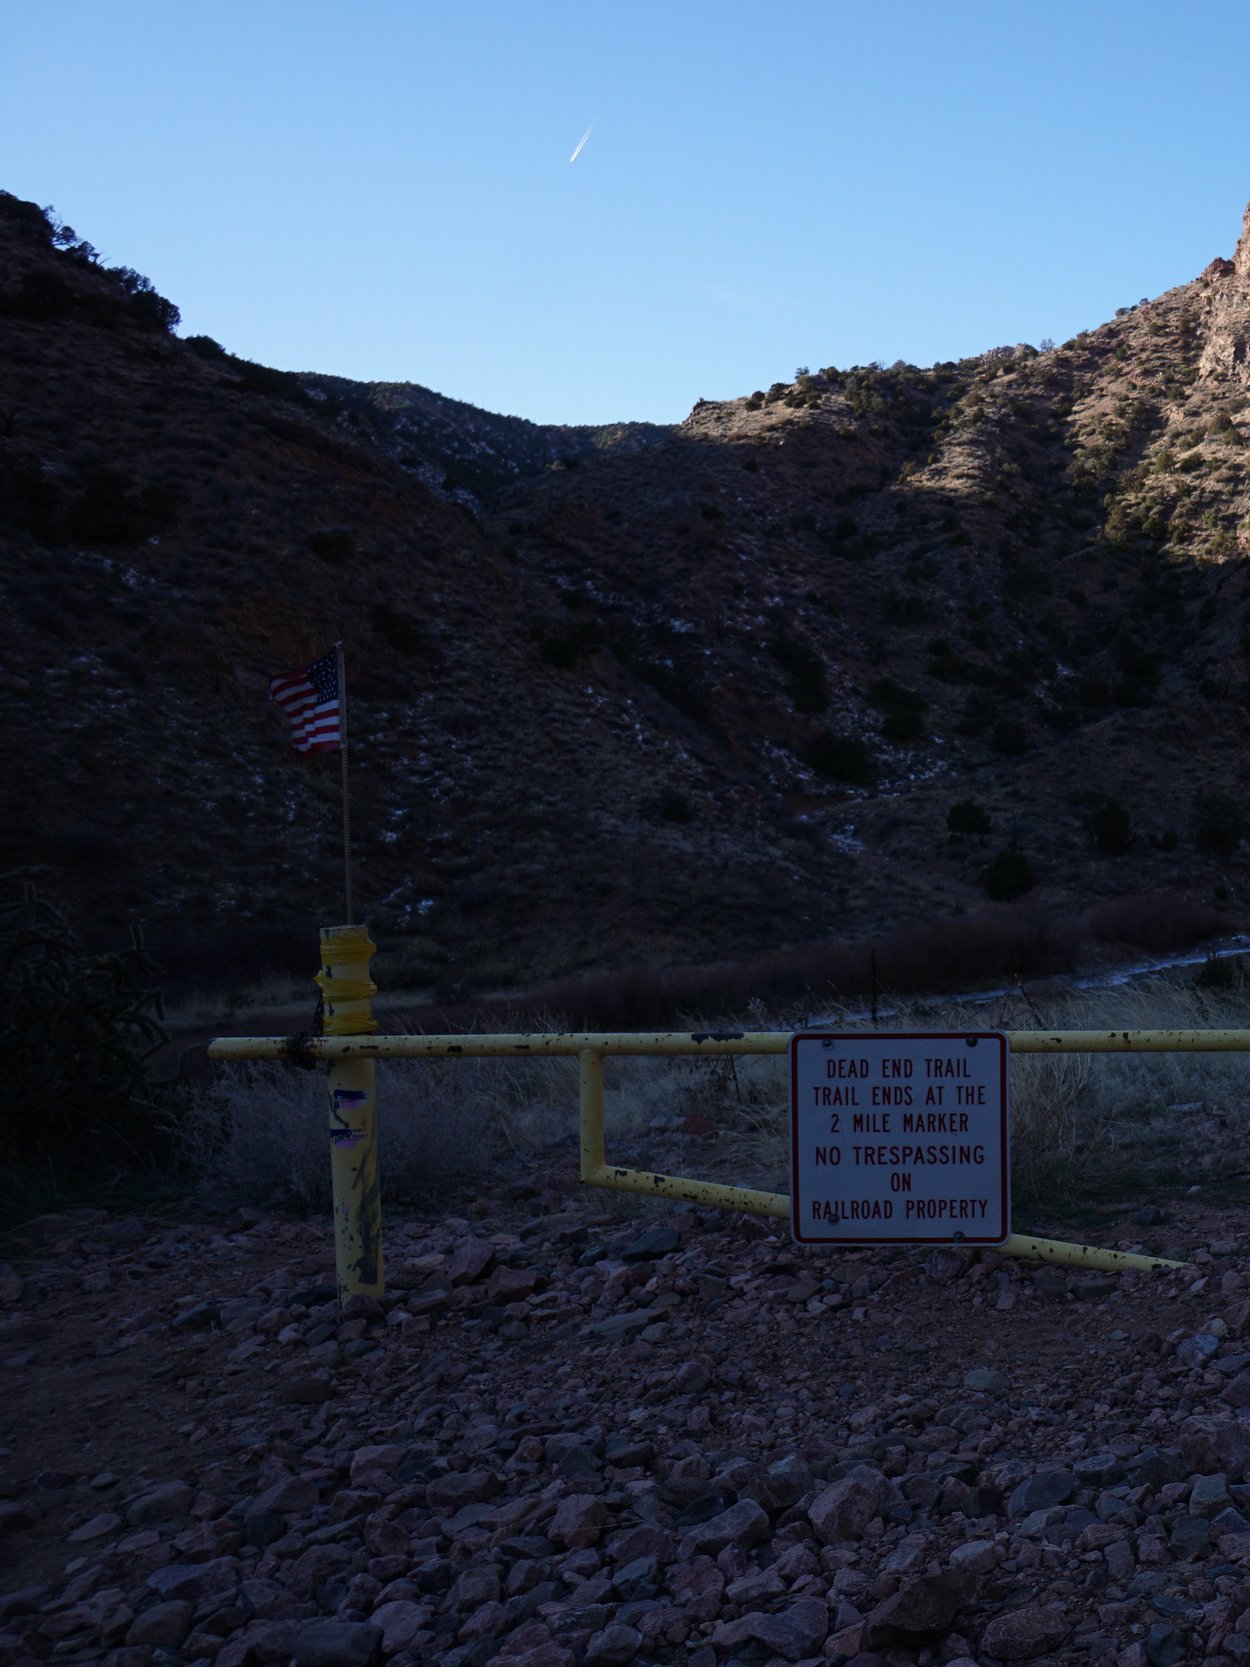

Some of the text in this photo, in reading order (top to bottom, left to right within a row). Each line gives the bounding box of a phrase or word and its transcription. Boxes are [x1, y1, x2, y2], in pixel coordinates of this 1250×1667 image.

[827, 1058, 971, 1078] DEAD END TRAIL
[813, 1086, 986, 1105] TRAIL ENDS AT THE
[831, 1114, 968, 1133] 2 MILE MARKER
[816, 1146, 984, 1165] NO TRESPASSING
[891, 1173, 911, 1192] ON
[813, 1200, 988, 1219] RAILROAD PROPERTY
